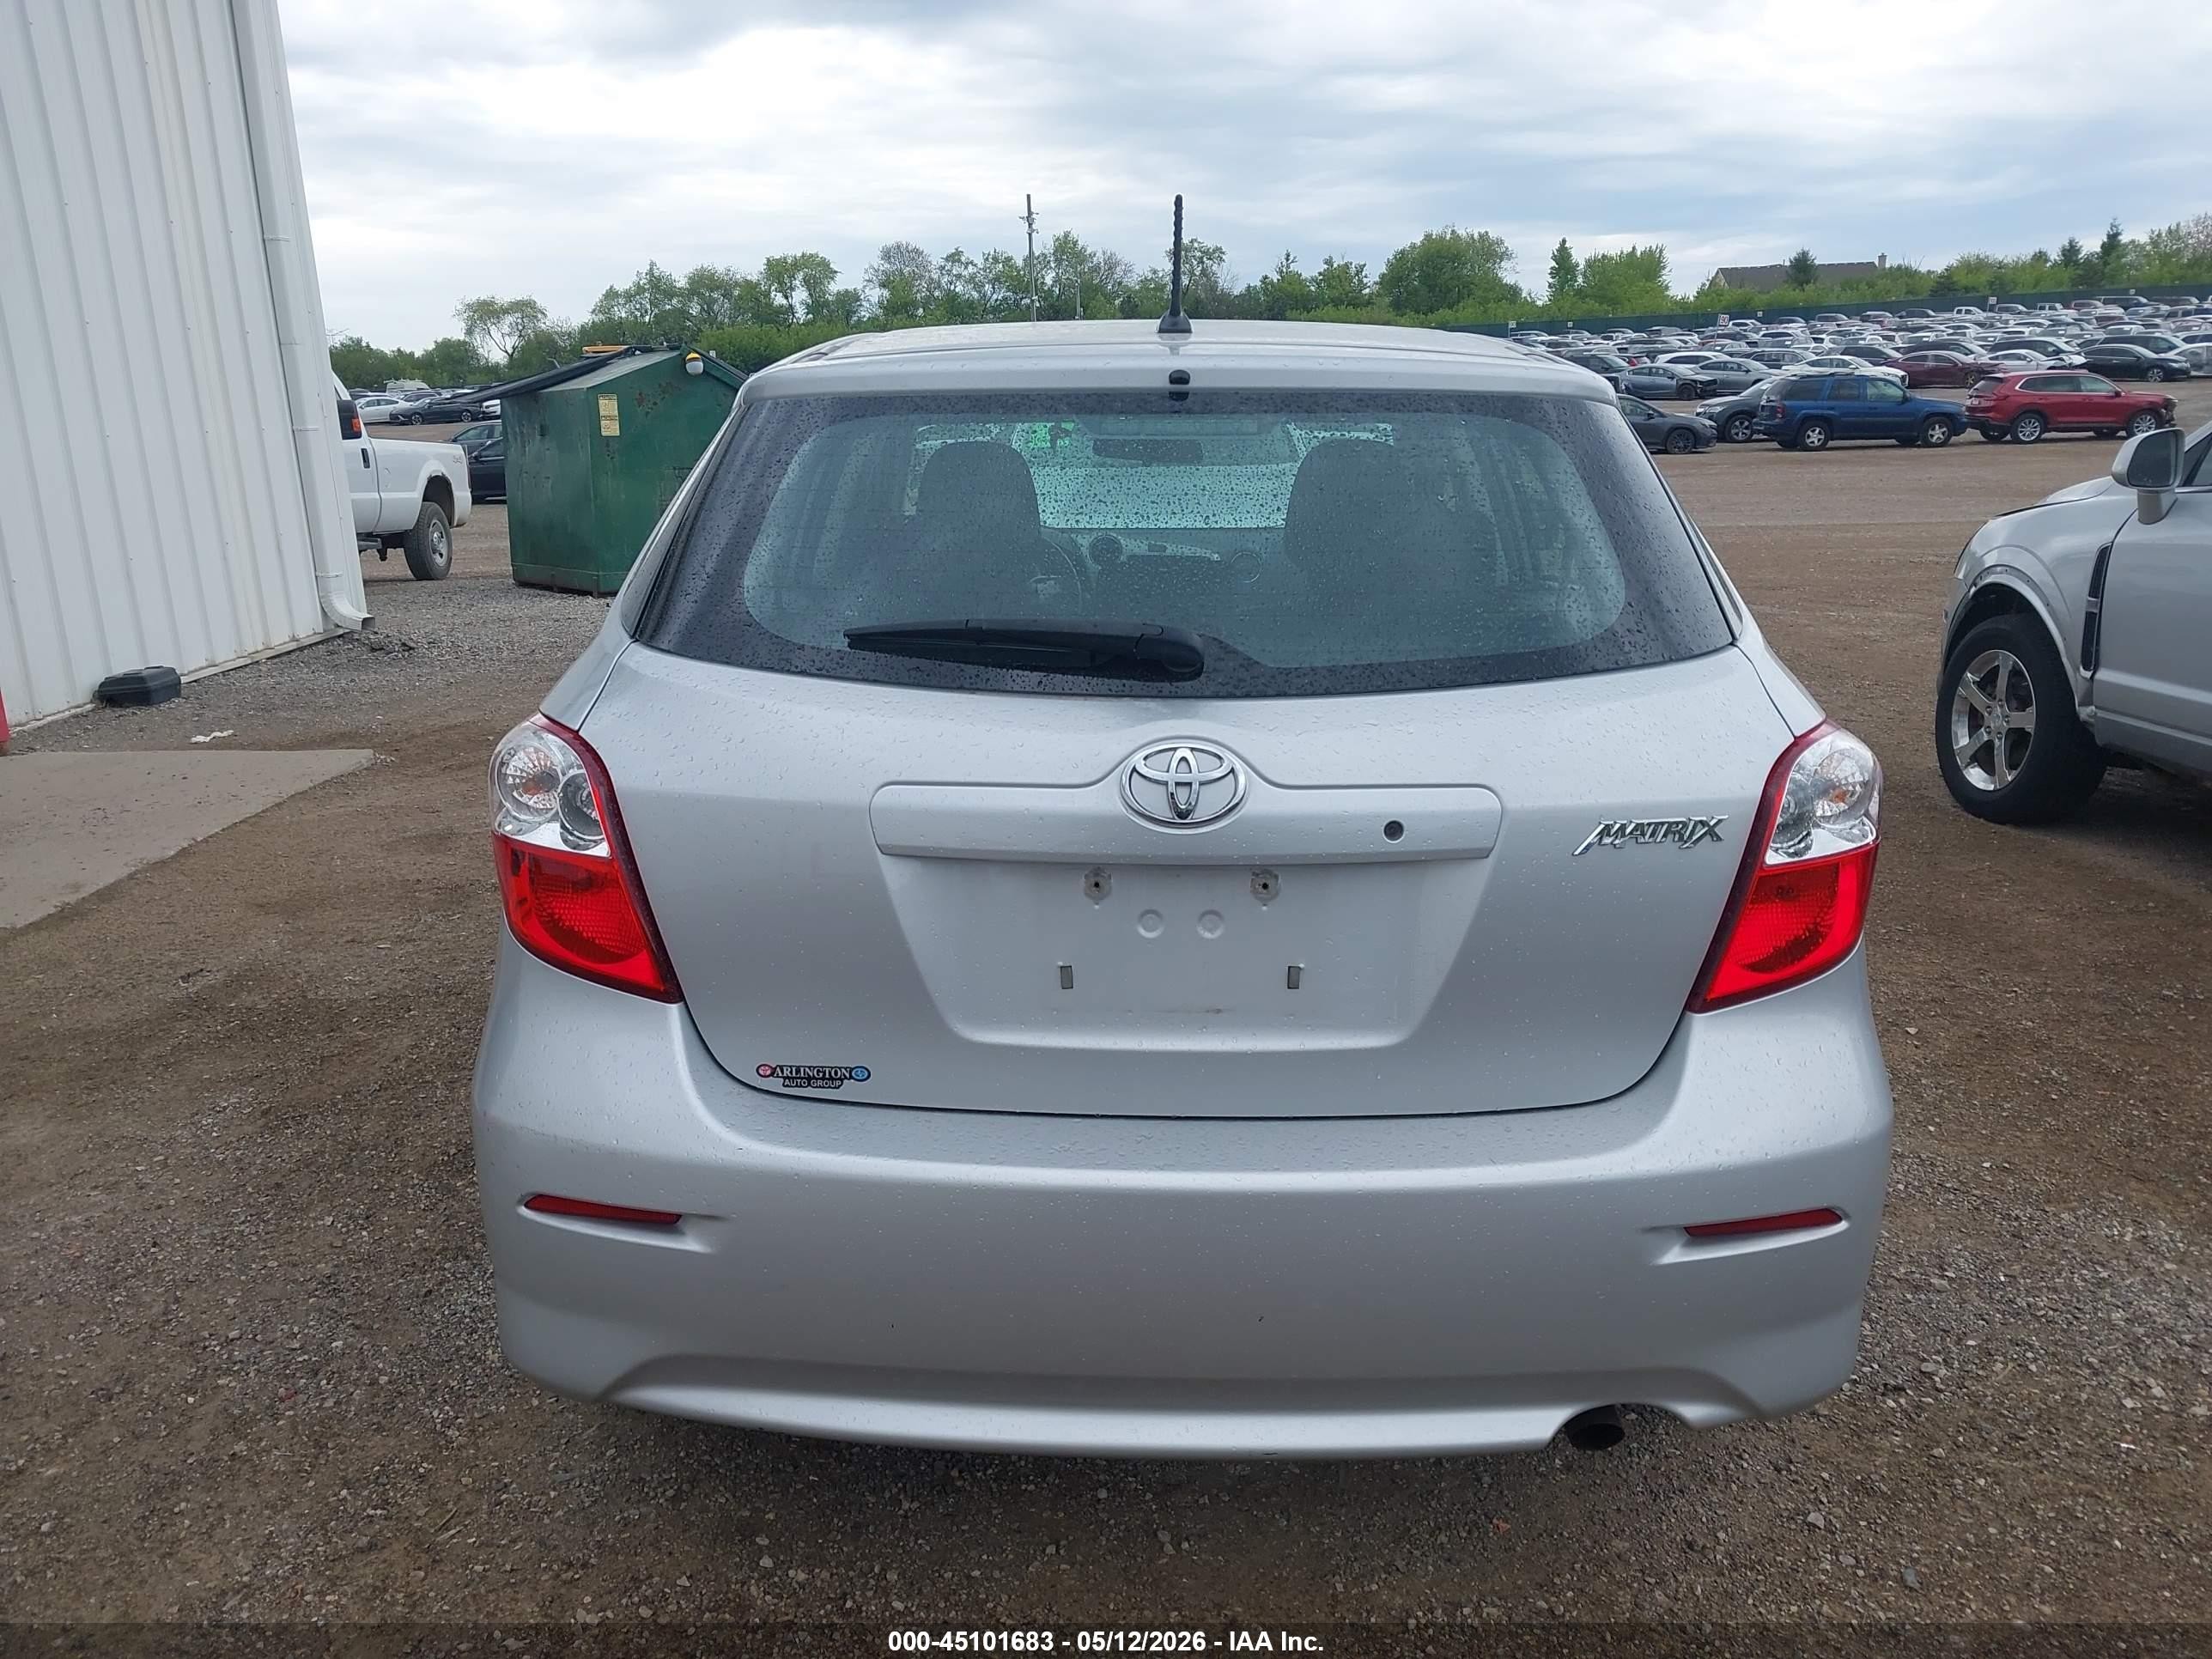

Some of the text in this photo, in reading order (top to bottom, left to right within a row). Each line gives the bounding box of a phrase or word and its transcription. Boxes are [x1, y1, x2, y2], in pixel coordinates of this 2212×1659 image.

[1572, 816, 1729, 855] MATRIX
[774, 1066, 851, 1079] ARLINGTON
[784, 1079, 842, 1088] AUTO GROUP
